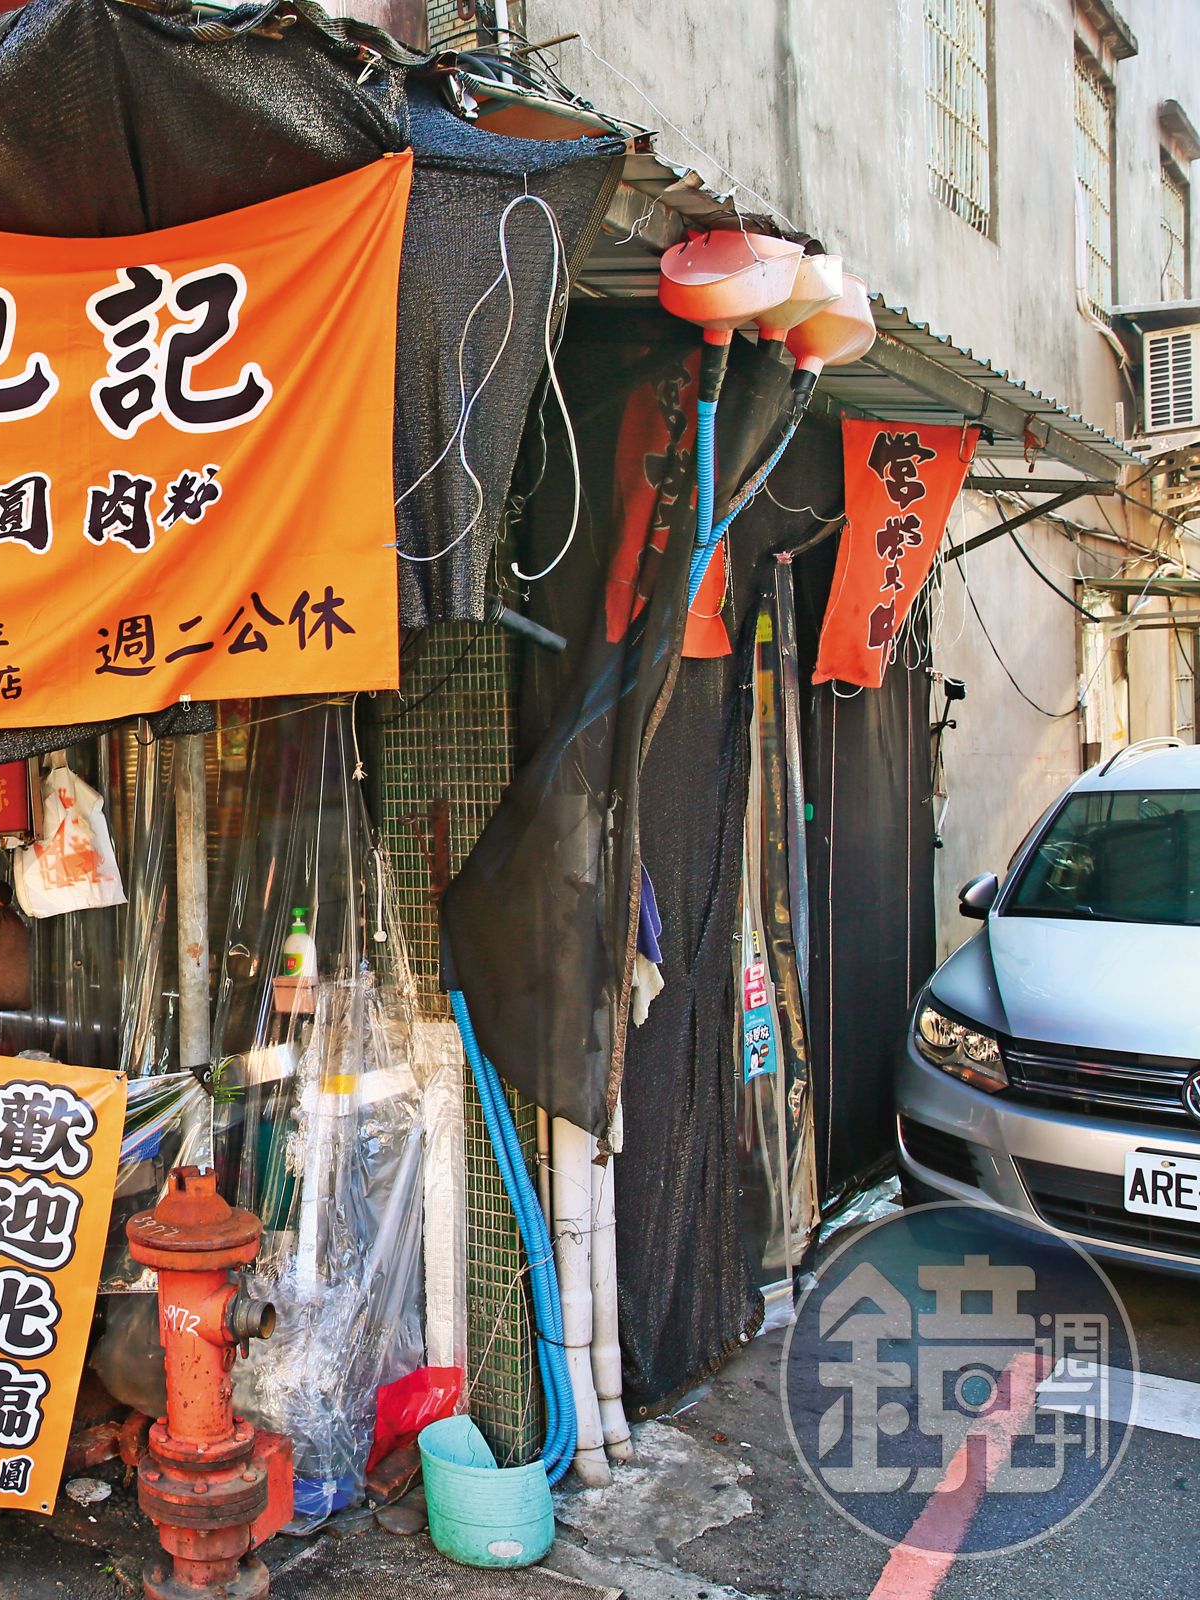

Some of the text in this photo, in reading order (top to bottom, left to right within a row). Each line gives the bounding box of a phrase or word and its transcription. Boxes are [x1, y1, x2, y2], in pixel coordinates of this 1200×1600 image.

[95, 586, 356, 677] 週二公休
[134, 1216, 180, 1237] 5972
